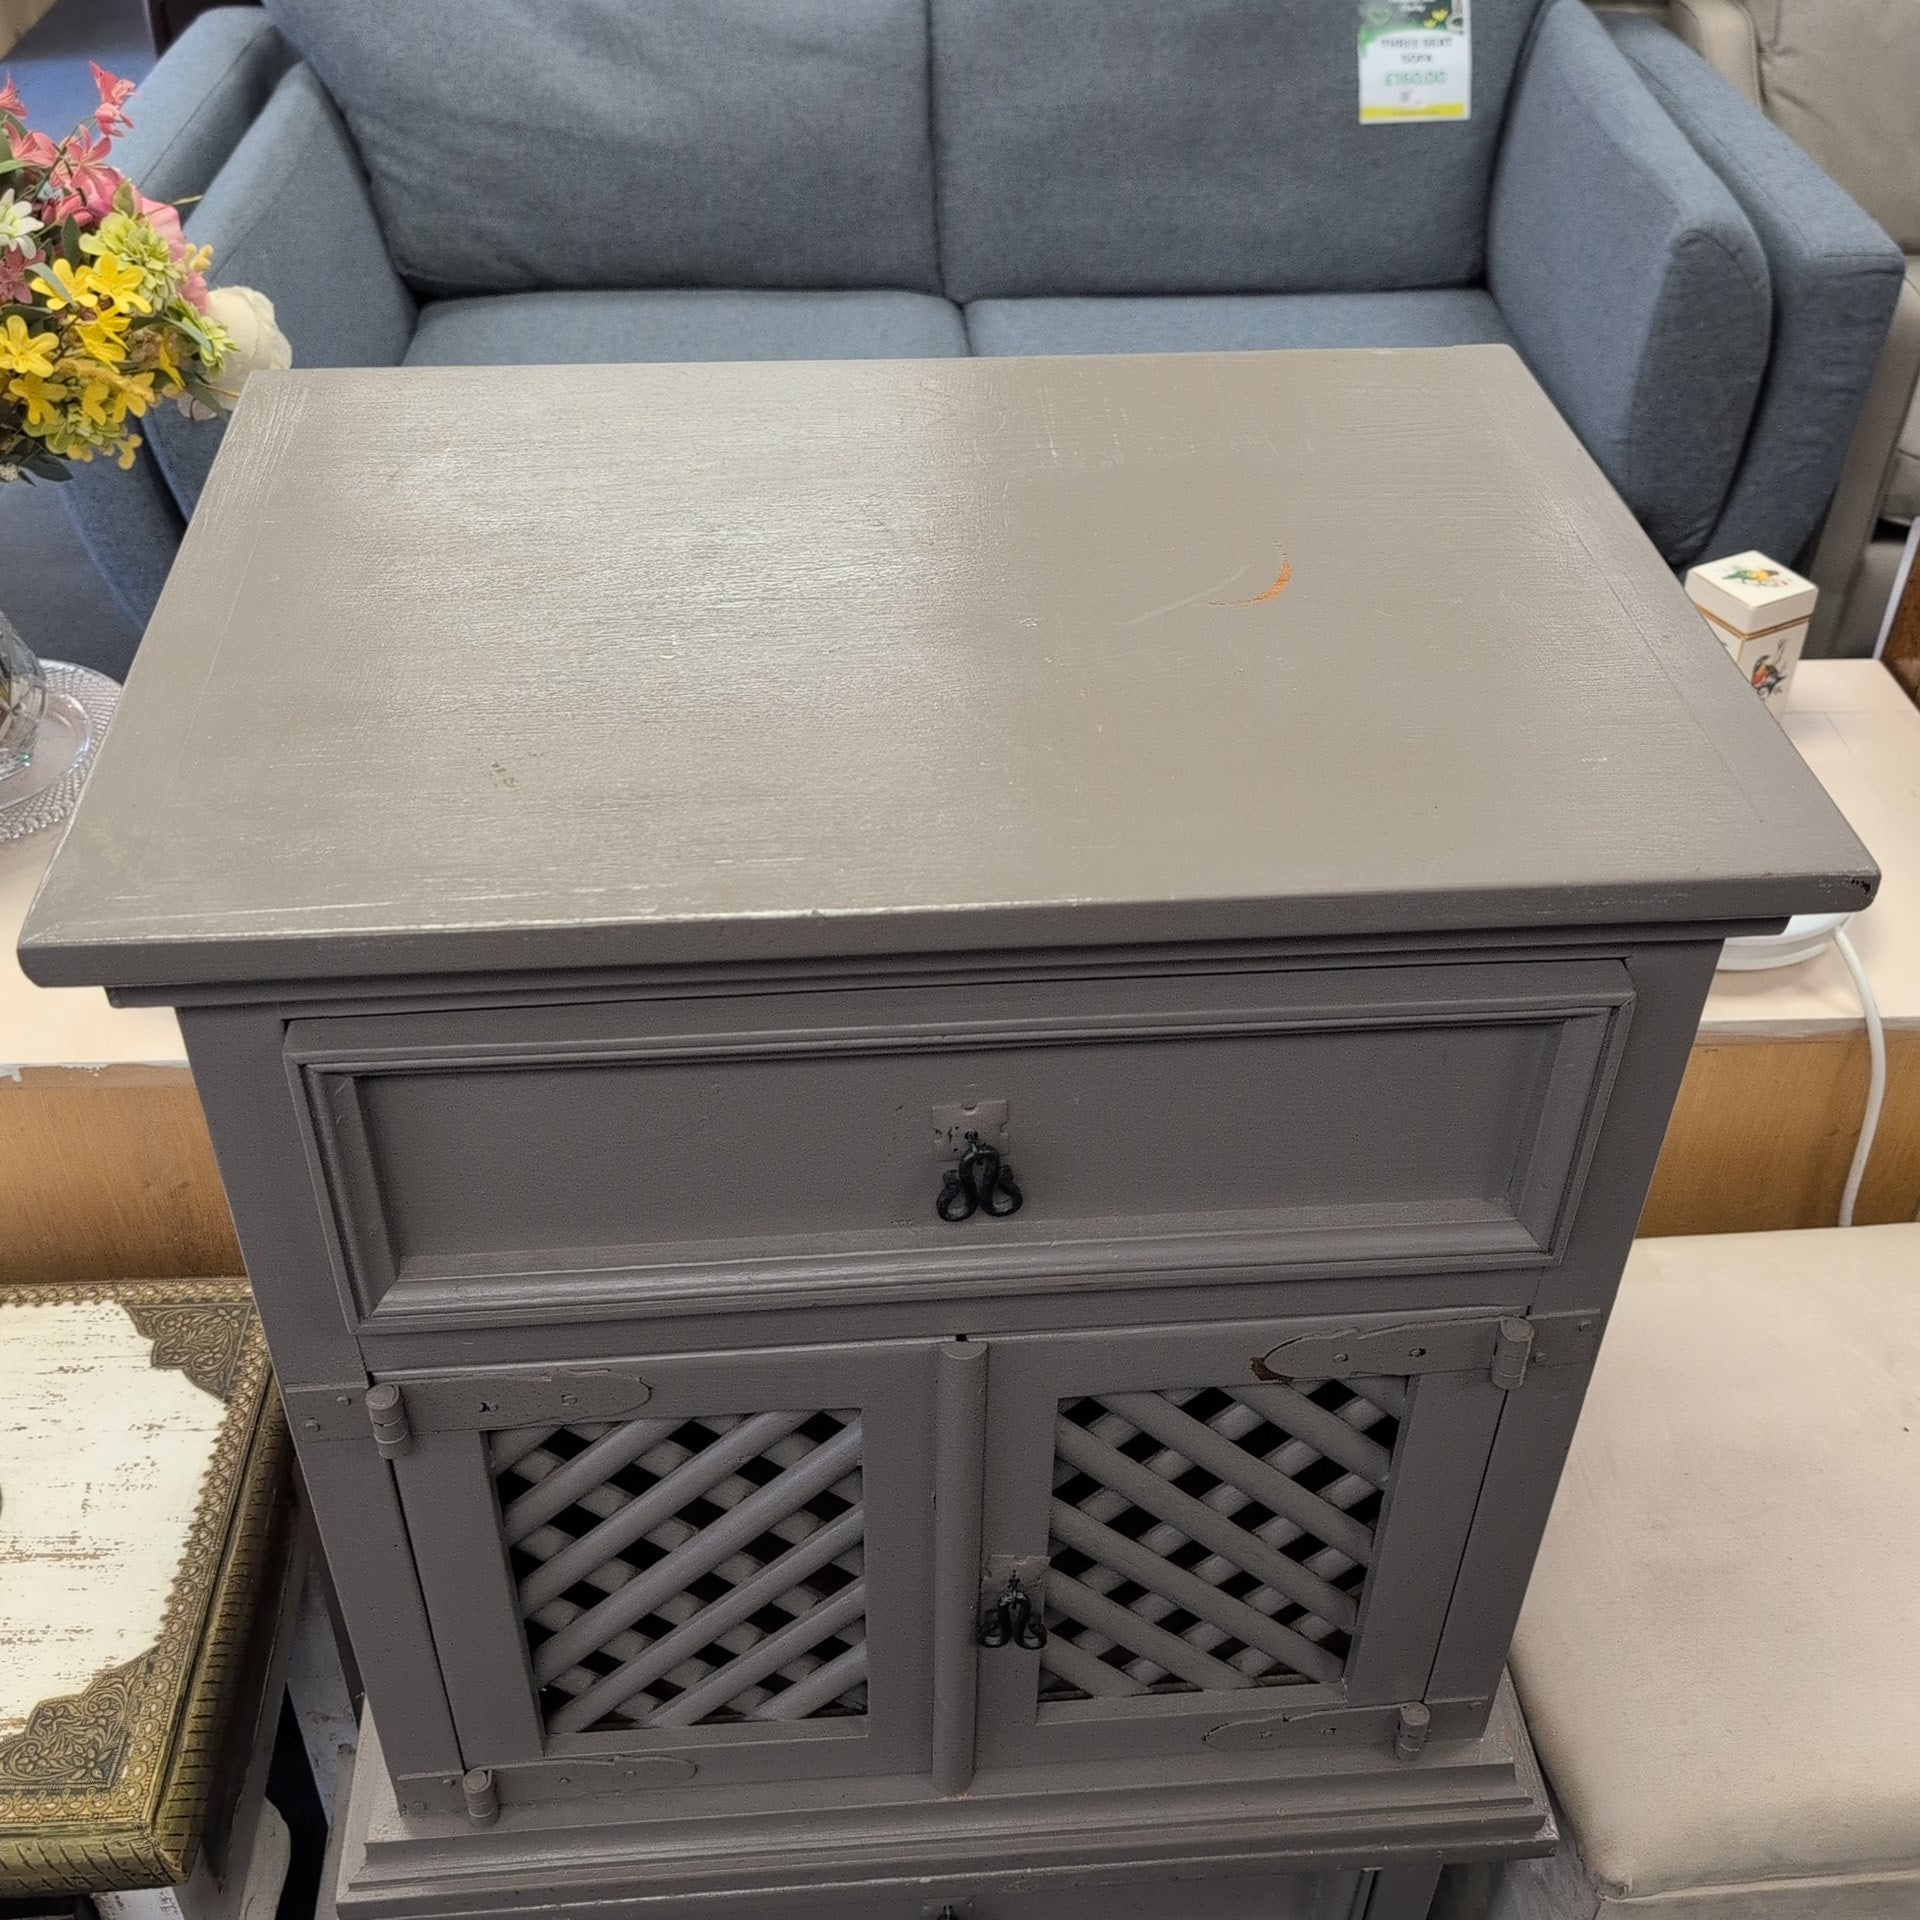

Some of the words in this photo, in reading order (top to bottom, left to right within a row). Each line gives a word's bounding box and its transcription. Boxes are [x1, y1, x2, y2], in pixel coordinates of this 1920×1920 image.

[1381, 38, 1418, 48] THREE
[1423, 37, 1453, 48] SEAT
[1400, 52, 1433, 64] SOFA
